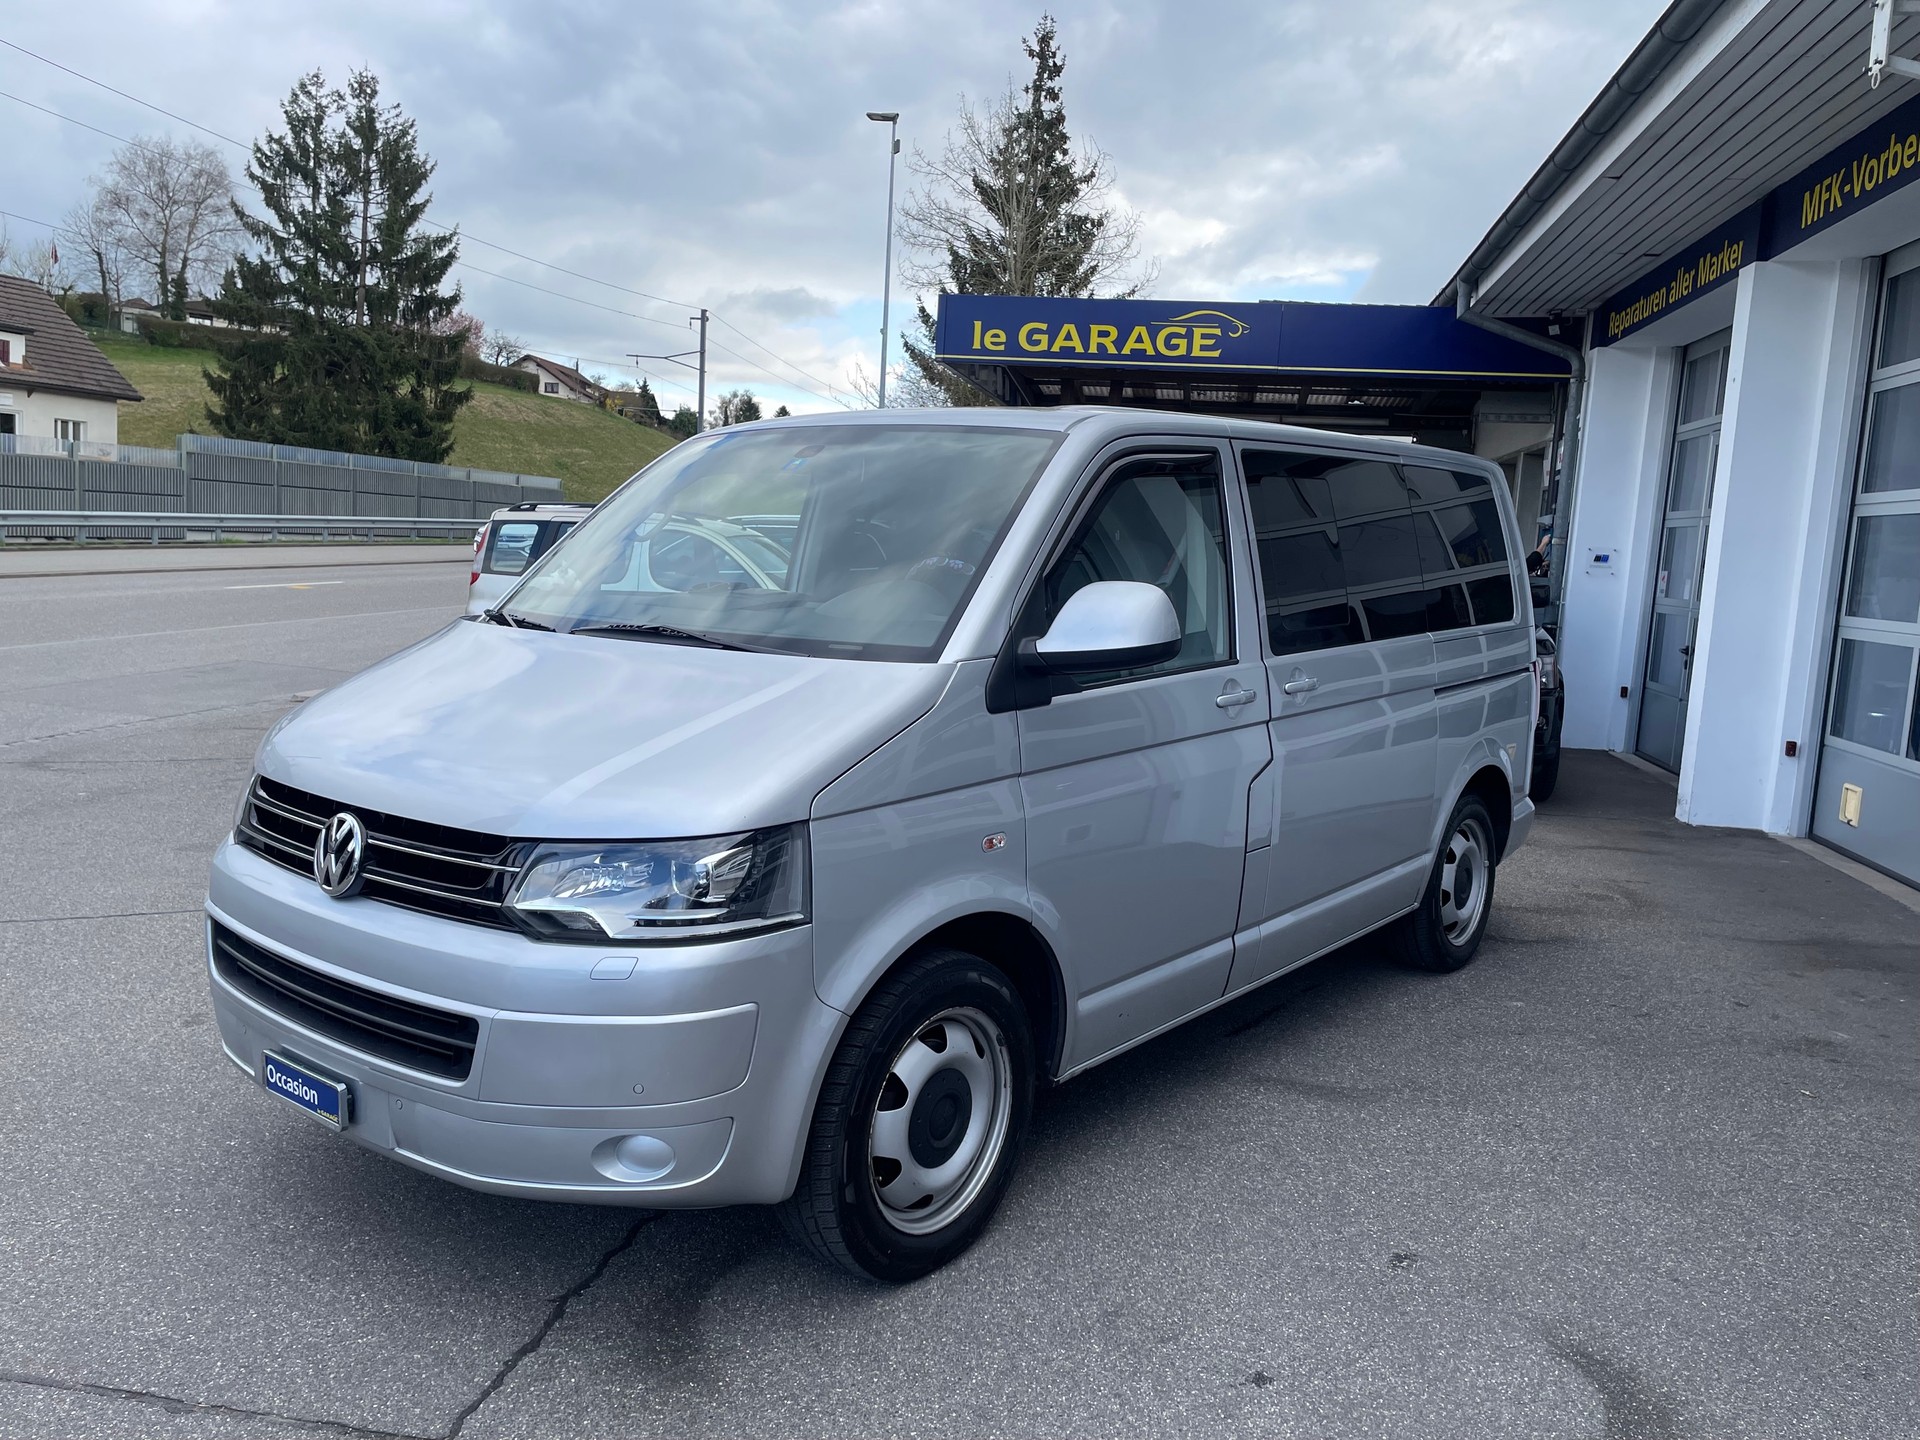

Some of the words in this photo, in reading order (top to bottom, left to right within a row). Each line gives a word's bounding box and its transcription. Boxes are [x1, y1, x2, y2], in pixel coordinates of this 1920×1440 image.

[1608, 286, 1667, 338] Reparaturen
[1668, 266, 1696, 304] aller
[971, 320, 1007, 350] le
[1017, 322, 1222, 358] GARAGE
[266, 1064, 318, 1105] Occasion
